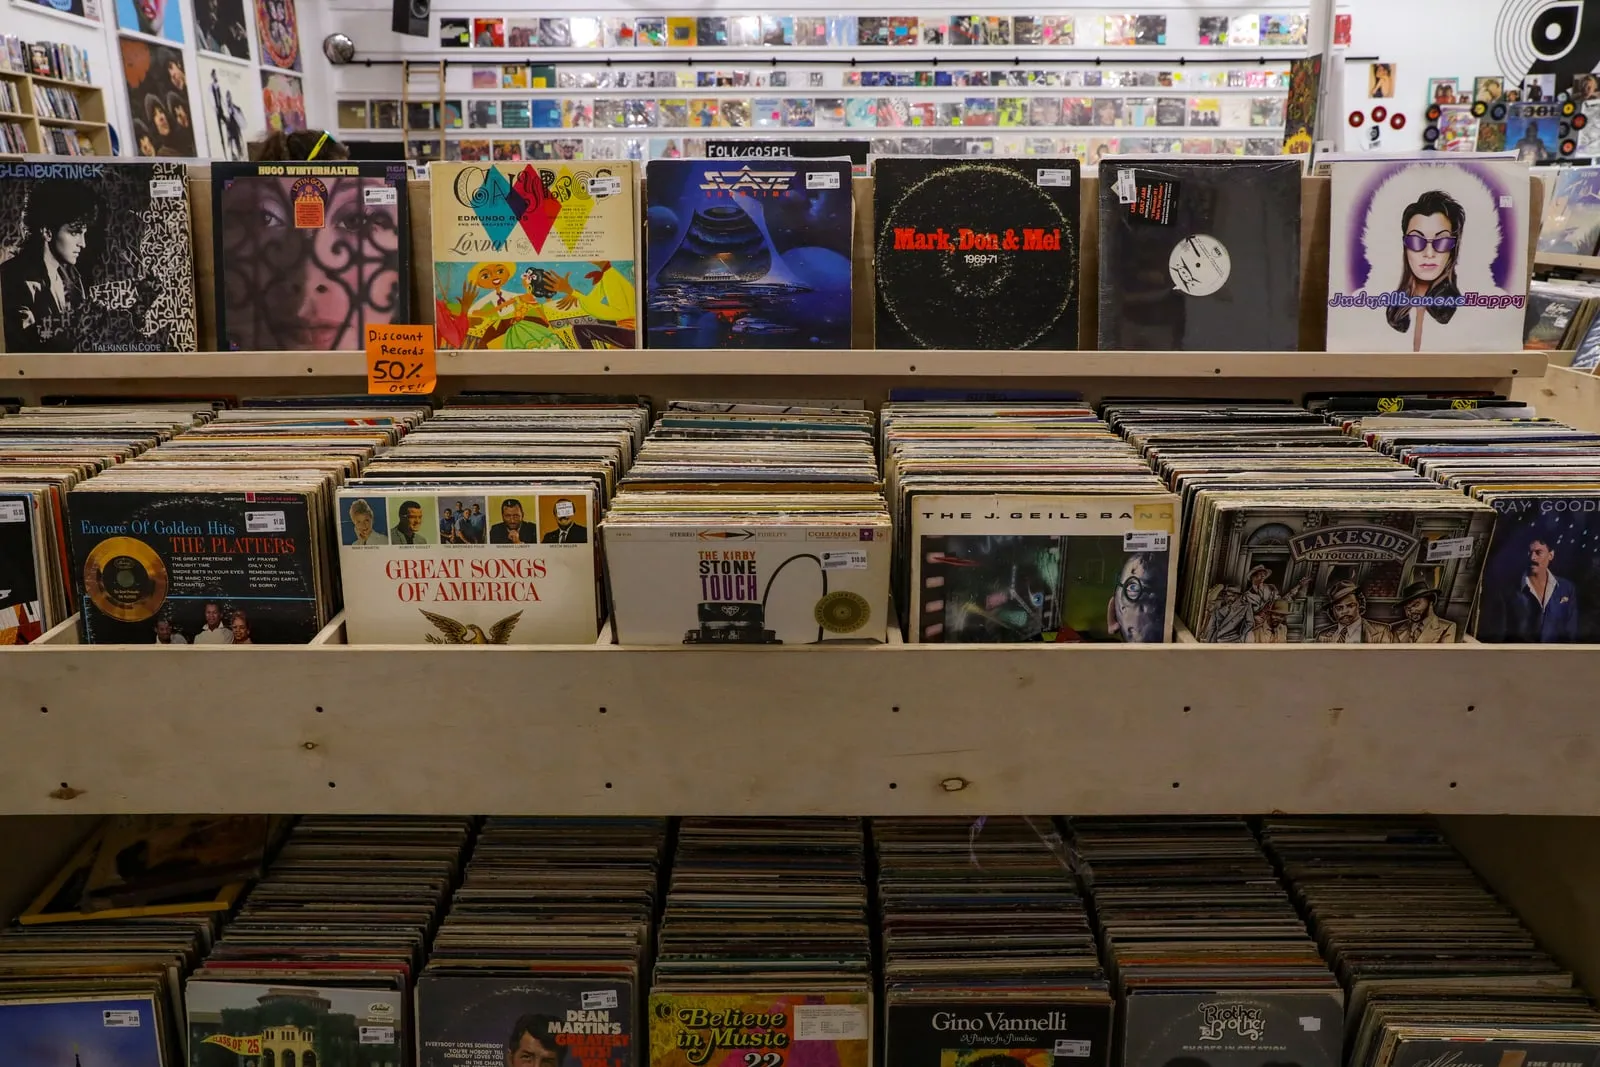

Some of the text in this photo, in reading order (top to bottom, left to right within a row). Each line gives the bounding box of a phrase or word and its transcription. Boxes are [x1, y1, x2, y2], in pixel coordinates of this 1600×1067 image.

[708, 144, 793, 158] FOLK/GOSPEL
[257, 166, 359, 176] HUGO WINTERHALTER
[699, 165, 799, 190] SLAVE
[292, 177, 326, 193] LATIN GOLD
[893, 228, 1062, 255] Mark, Don & Mel
[963, 254, 998, 264] 1969-71
[369, 330, 423, 342] Discount
[381, 344, 424, 356] Records
[373, 359, 423, 380] 50%
[1494, 500, 1600, 513] RAY GOOD
[922, 512, 973, 520] THE
[984, 512, 1001, 520] J.
[1009, 512, 1089, 520] GEILS
[81, 520, 236, 535] Encore Of Golden Hits
[169, 537, 298, 555] THE PLATTERS
[1299, 530, 1410, 553] LAKESIDE
[698, 551, 757, 561] THE KIRBY
[1309, 550, 1395, 560] UNTOUCHABLES
[385, 560, 548, 580] GREAT SONGS
[699, 561, 757, 575] STONE
[398, 582, 542, 602] OF AMERICA
[700, 575, 758, 600] TOUCH
[567, 1010, 609, 1022] DEAN
[677, 1008, 785, 1029] Believe
[932, 1011, 1068, 1031] Gino Vannelli
[1198, 1003, 1262, 1026] Brother
[548, 1022, 622, 1034] MARTIN'S
[1211, 1017, 1267, 1041] Brother
[555, 1034, 630, 1046] GREATEST
[674, 1027, 788, 1064] in Music
